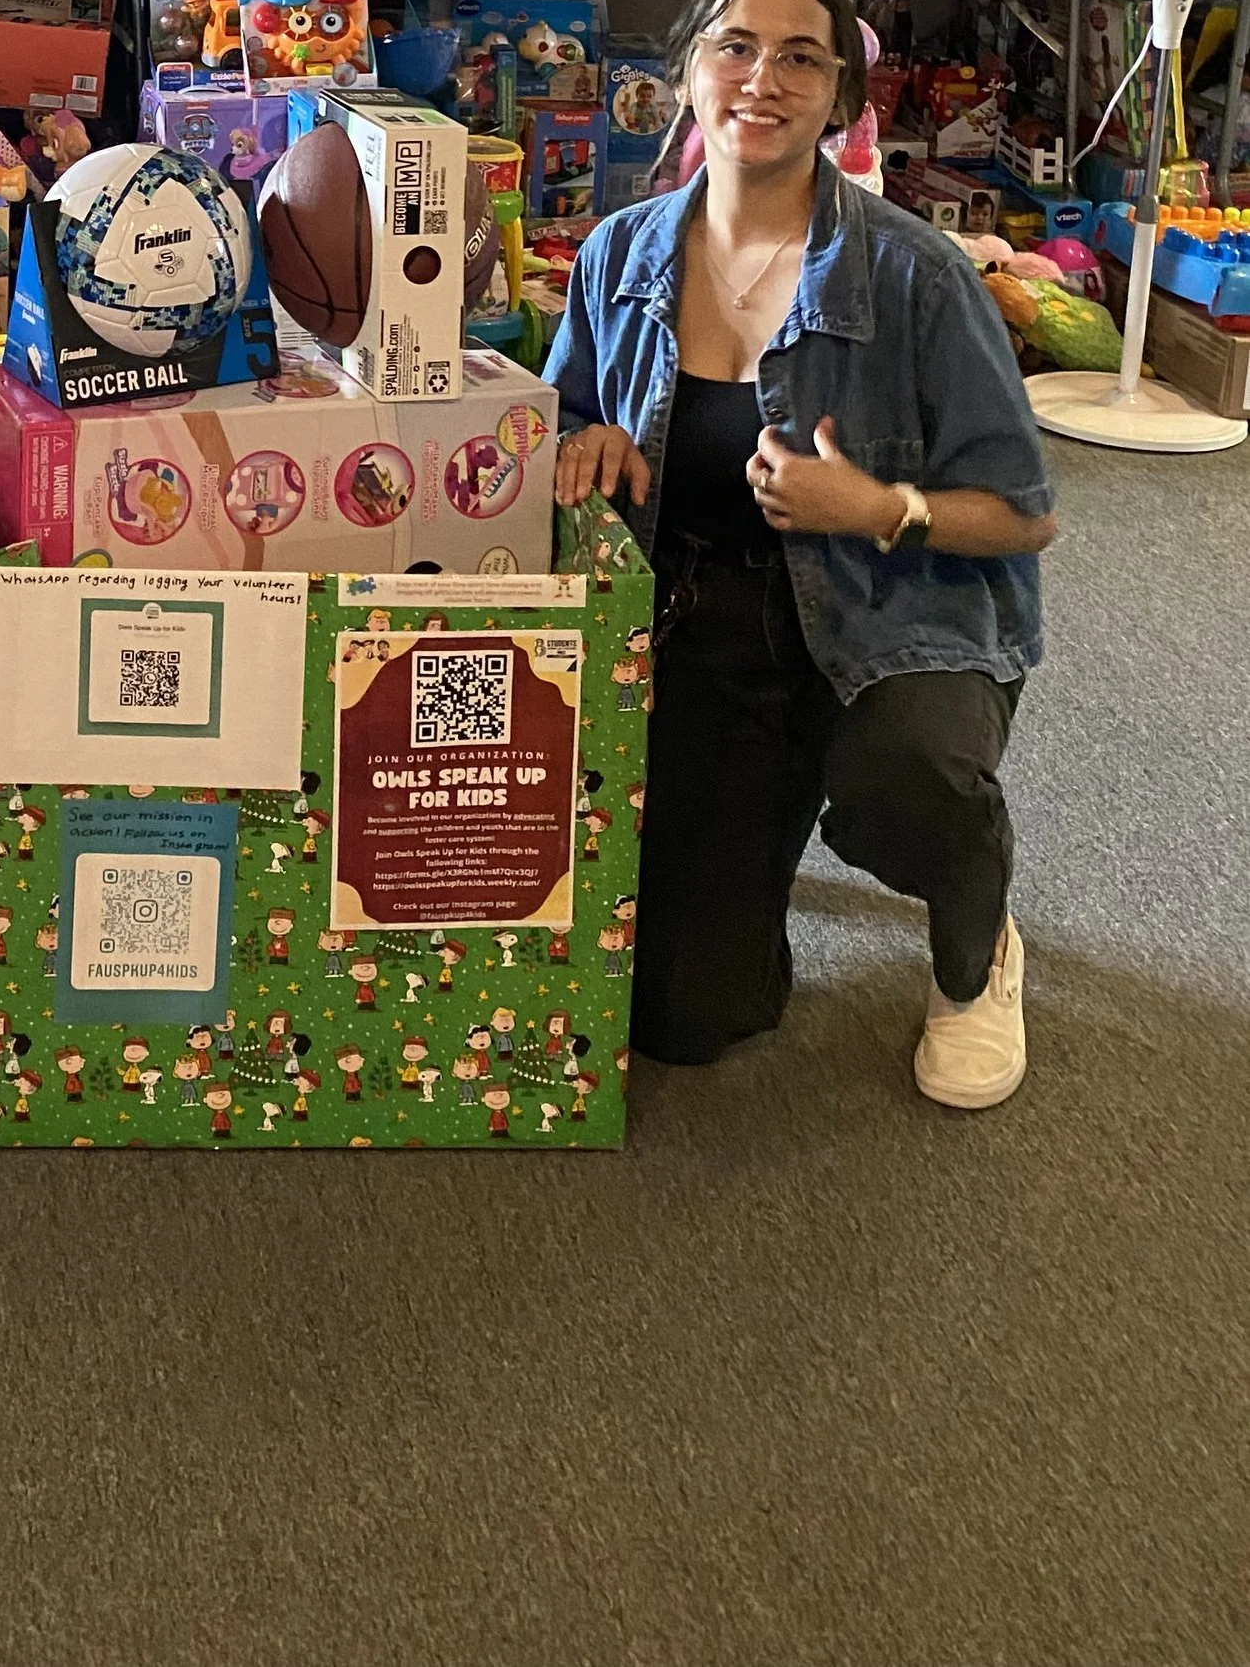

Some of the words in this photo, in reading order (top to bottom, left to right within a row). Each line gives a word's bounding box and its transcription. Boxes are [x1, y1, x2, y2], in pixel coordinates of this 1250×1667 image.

[610, 68, 651, 85] Giggles
[364, 135, 376, 178] FEEL
[396, 141, 422, 187] MVP
[408, 191, 420, 206] AN
[393, 191, 407, 234] BECOME
[1055, 210, 1082, 223] vtech
[246, 307, 282, 379] 5
[385, 323, 399, 397] SPALDING.com
[64, 369, 141, 402] SOCCER
[144, 362, 189, 387] BALL
[509, 405, 532, 463] FLIPPING
[530, 420, 549, 437] 4
[118, 448, 128, 478] Sizzle
[110, 464, 120, 493] Sizzle
[52, 464, 69, 520] WARNING:
[78, 574, 135, 590] regarding
[143, 575, 188, 591] logging
[260, 591, 302, 605] hours!
[546, 639, 578, 647] STUDENTS
[367, 754, 400, 765] JOIN
[406, 753, 434, 763] OUR
[440, 750, 551, 762] ORGANIZATION:
[372, 769, 432, 789] OWLS
[438, 766, 509, 786] SPEAK
[515, 767, 547, 786] UP
[409, 790, 450, 810] FOR
[456, 788, 508, 808] KIDS
[68, 806, 94, 823] See
[102, 809, 132, 822] our
[138, 809, 192, 822] mission
[197, 812, 214, 825] in
[398, 813, 430, 823] involved
[439, 813, 453, 821] our
[454, 812, 501, 822] organization
[124, 828, 167, 839] Follow
[168, 829, 185, 839] us
[190, 831, 207, 839] on
[420, 825, 433, 833] the
[434, 824, 464, 833] children
[465, 824, 481, 832] and
[481, 823, 503, 833] youth
[505, 823, 522, 831] that
[375, 850, 393, 861] Join
[393, 849, 414, 859] Owls
[415, 848, 441, 859] Speak
[442, 848, 454, 858] Up
[455, 847, 468, 856] for
[469, 847, 488, 856] Kids
[489, 847, 524, 857] through
[525, 847, 540, 856] the
[425, 858, 464, 869] following
[392, 901, 419, 911] Check
[419, 902, 435, 911] out
[436, 902, 450, 910] our
[451, 900, 494, 911] Instagram
[87, 962, 199, 979] FAUSPKUP4KIDS
